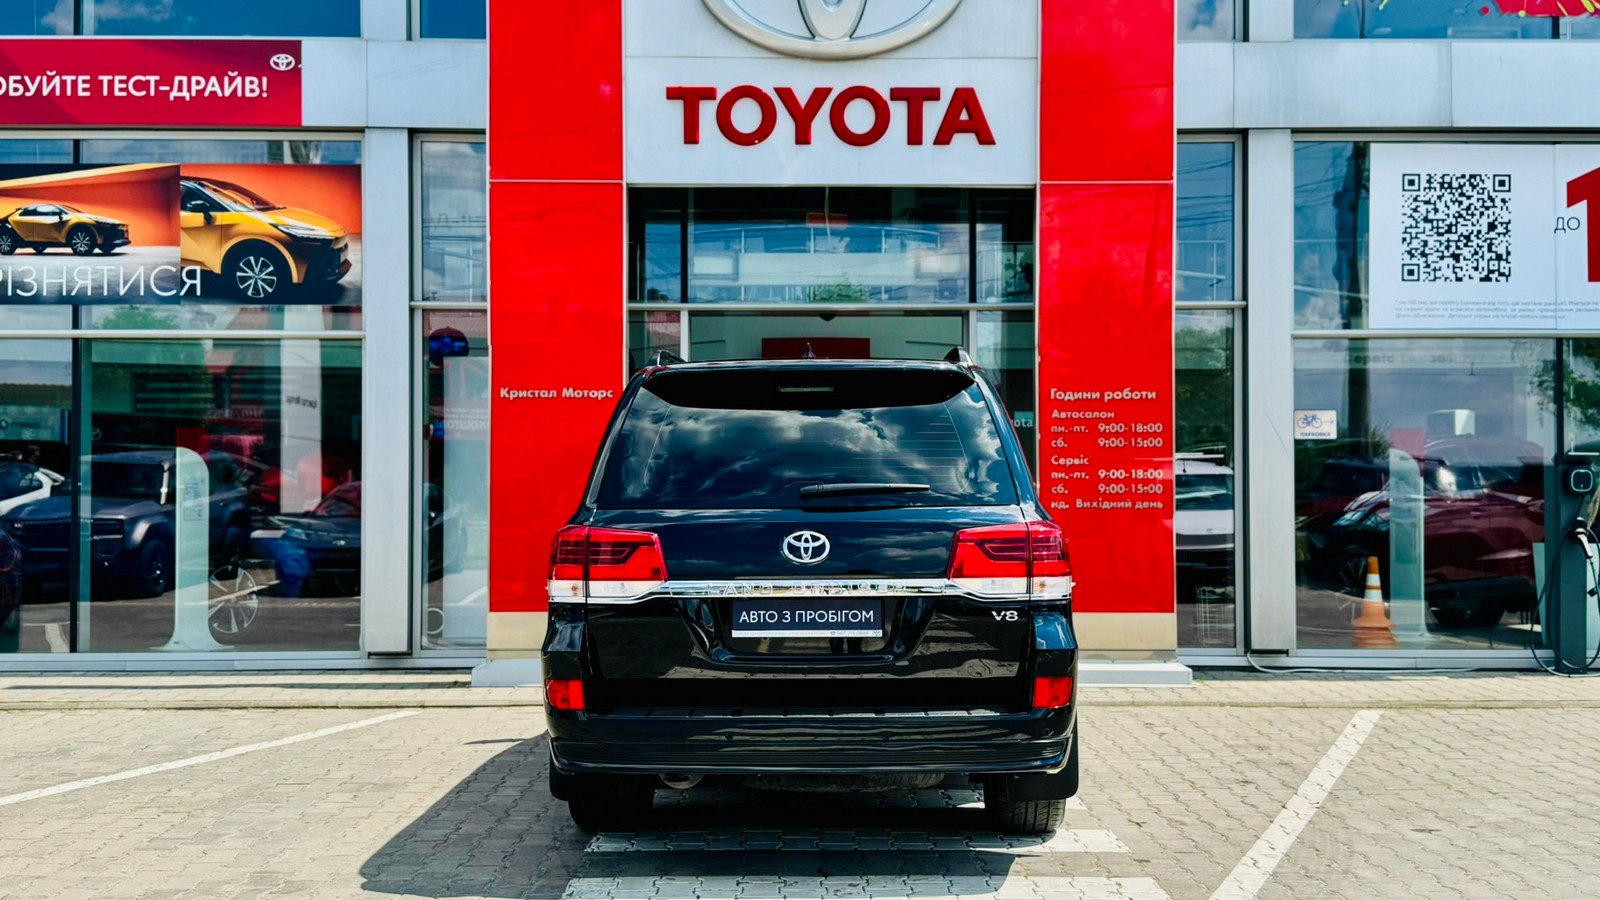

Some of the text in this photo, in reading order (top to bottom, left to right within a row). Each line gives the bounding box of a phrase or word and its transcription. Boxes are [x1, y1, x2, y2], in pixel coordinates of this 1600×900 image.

[98, 71, 268, 102] ТЕСТ-ДРАЙВ!
[666, 85, 996, 147] TOYOTA
[0, 265, 202, 297] ІЗНЯТИСЯ
[500, 388, 614, 400] Кристал Моторс
[1051, 387, 1157, 402] Години роботи
[1052, 409, 1115, 419] Автосалон
[1051, 438, 1068, 448] сб.
[1051, 454, 1089, 466] Сервіс
[1051, 484, 1069, 494] сб.
[1051, 497, 1163, 510] нд. Вихідний день
[708, 582, 773, 595] LAND
[739, 611, 778, 623] АВТО
[796, 610, 874, 623] ПРОБІГОМ
[992, 610, 1019, 621] V8
